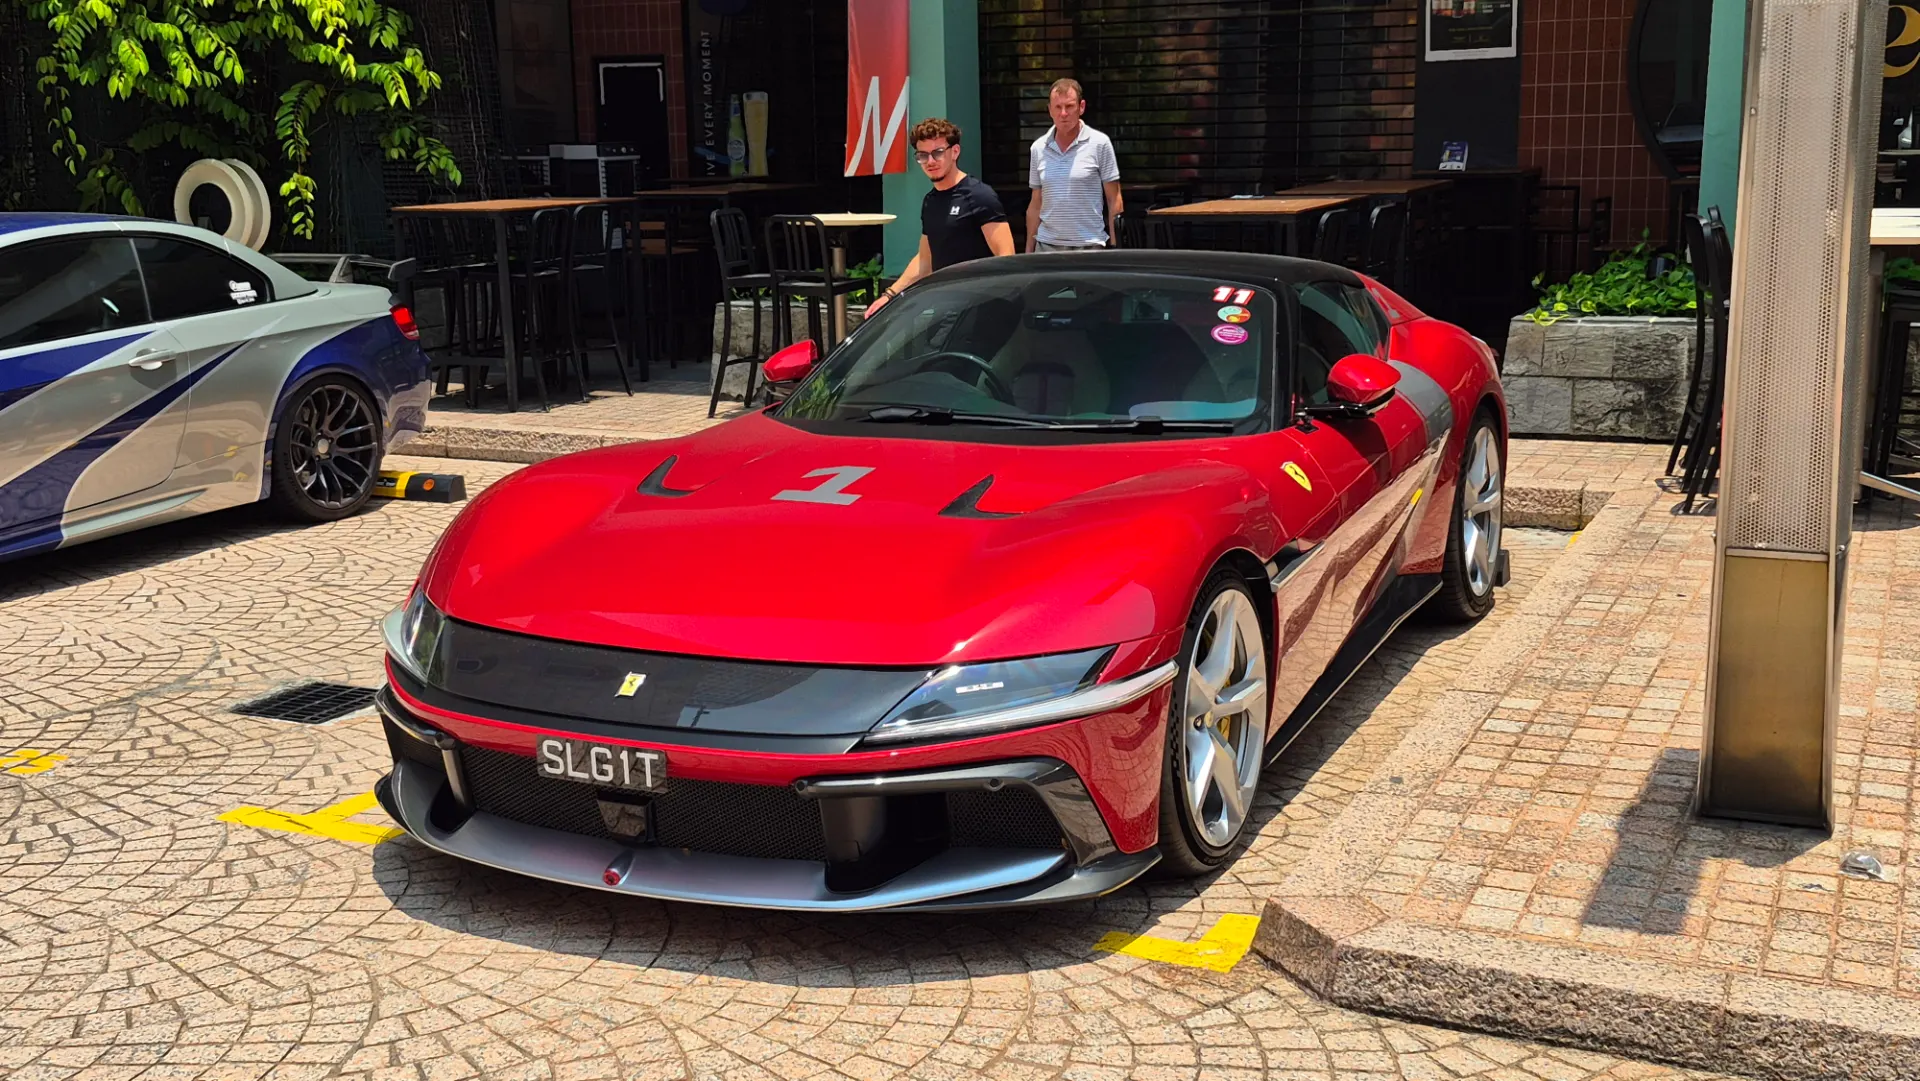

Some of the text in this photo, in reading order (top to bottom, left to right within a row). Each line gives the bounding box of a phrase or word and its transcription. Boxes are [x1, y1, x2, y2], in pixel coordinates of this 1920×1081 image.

[701, 31, 716, 176] IVE EVERY MOMENT
[1212, 286, 1255, 305] 11
[770, 466, 876, 505] 1
[542, 739, 659, 788] SLG1T
